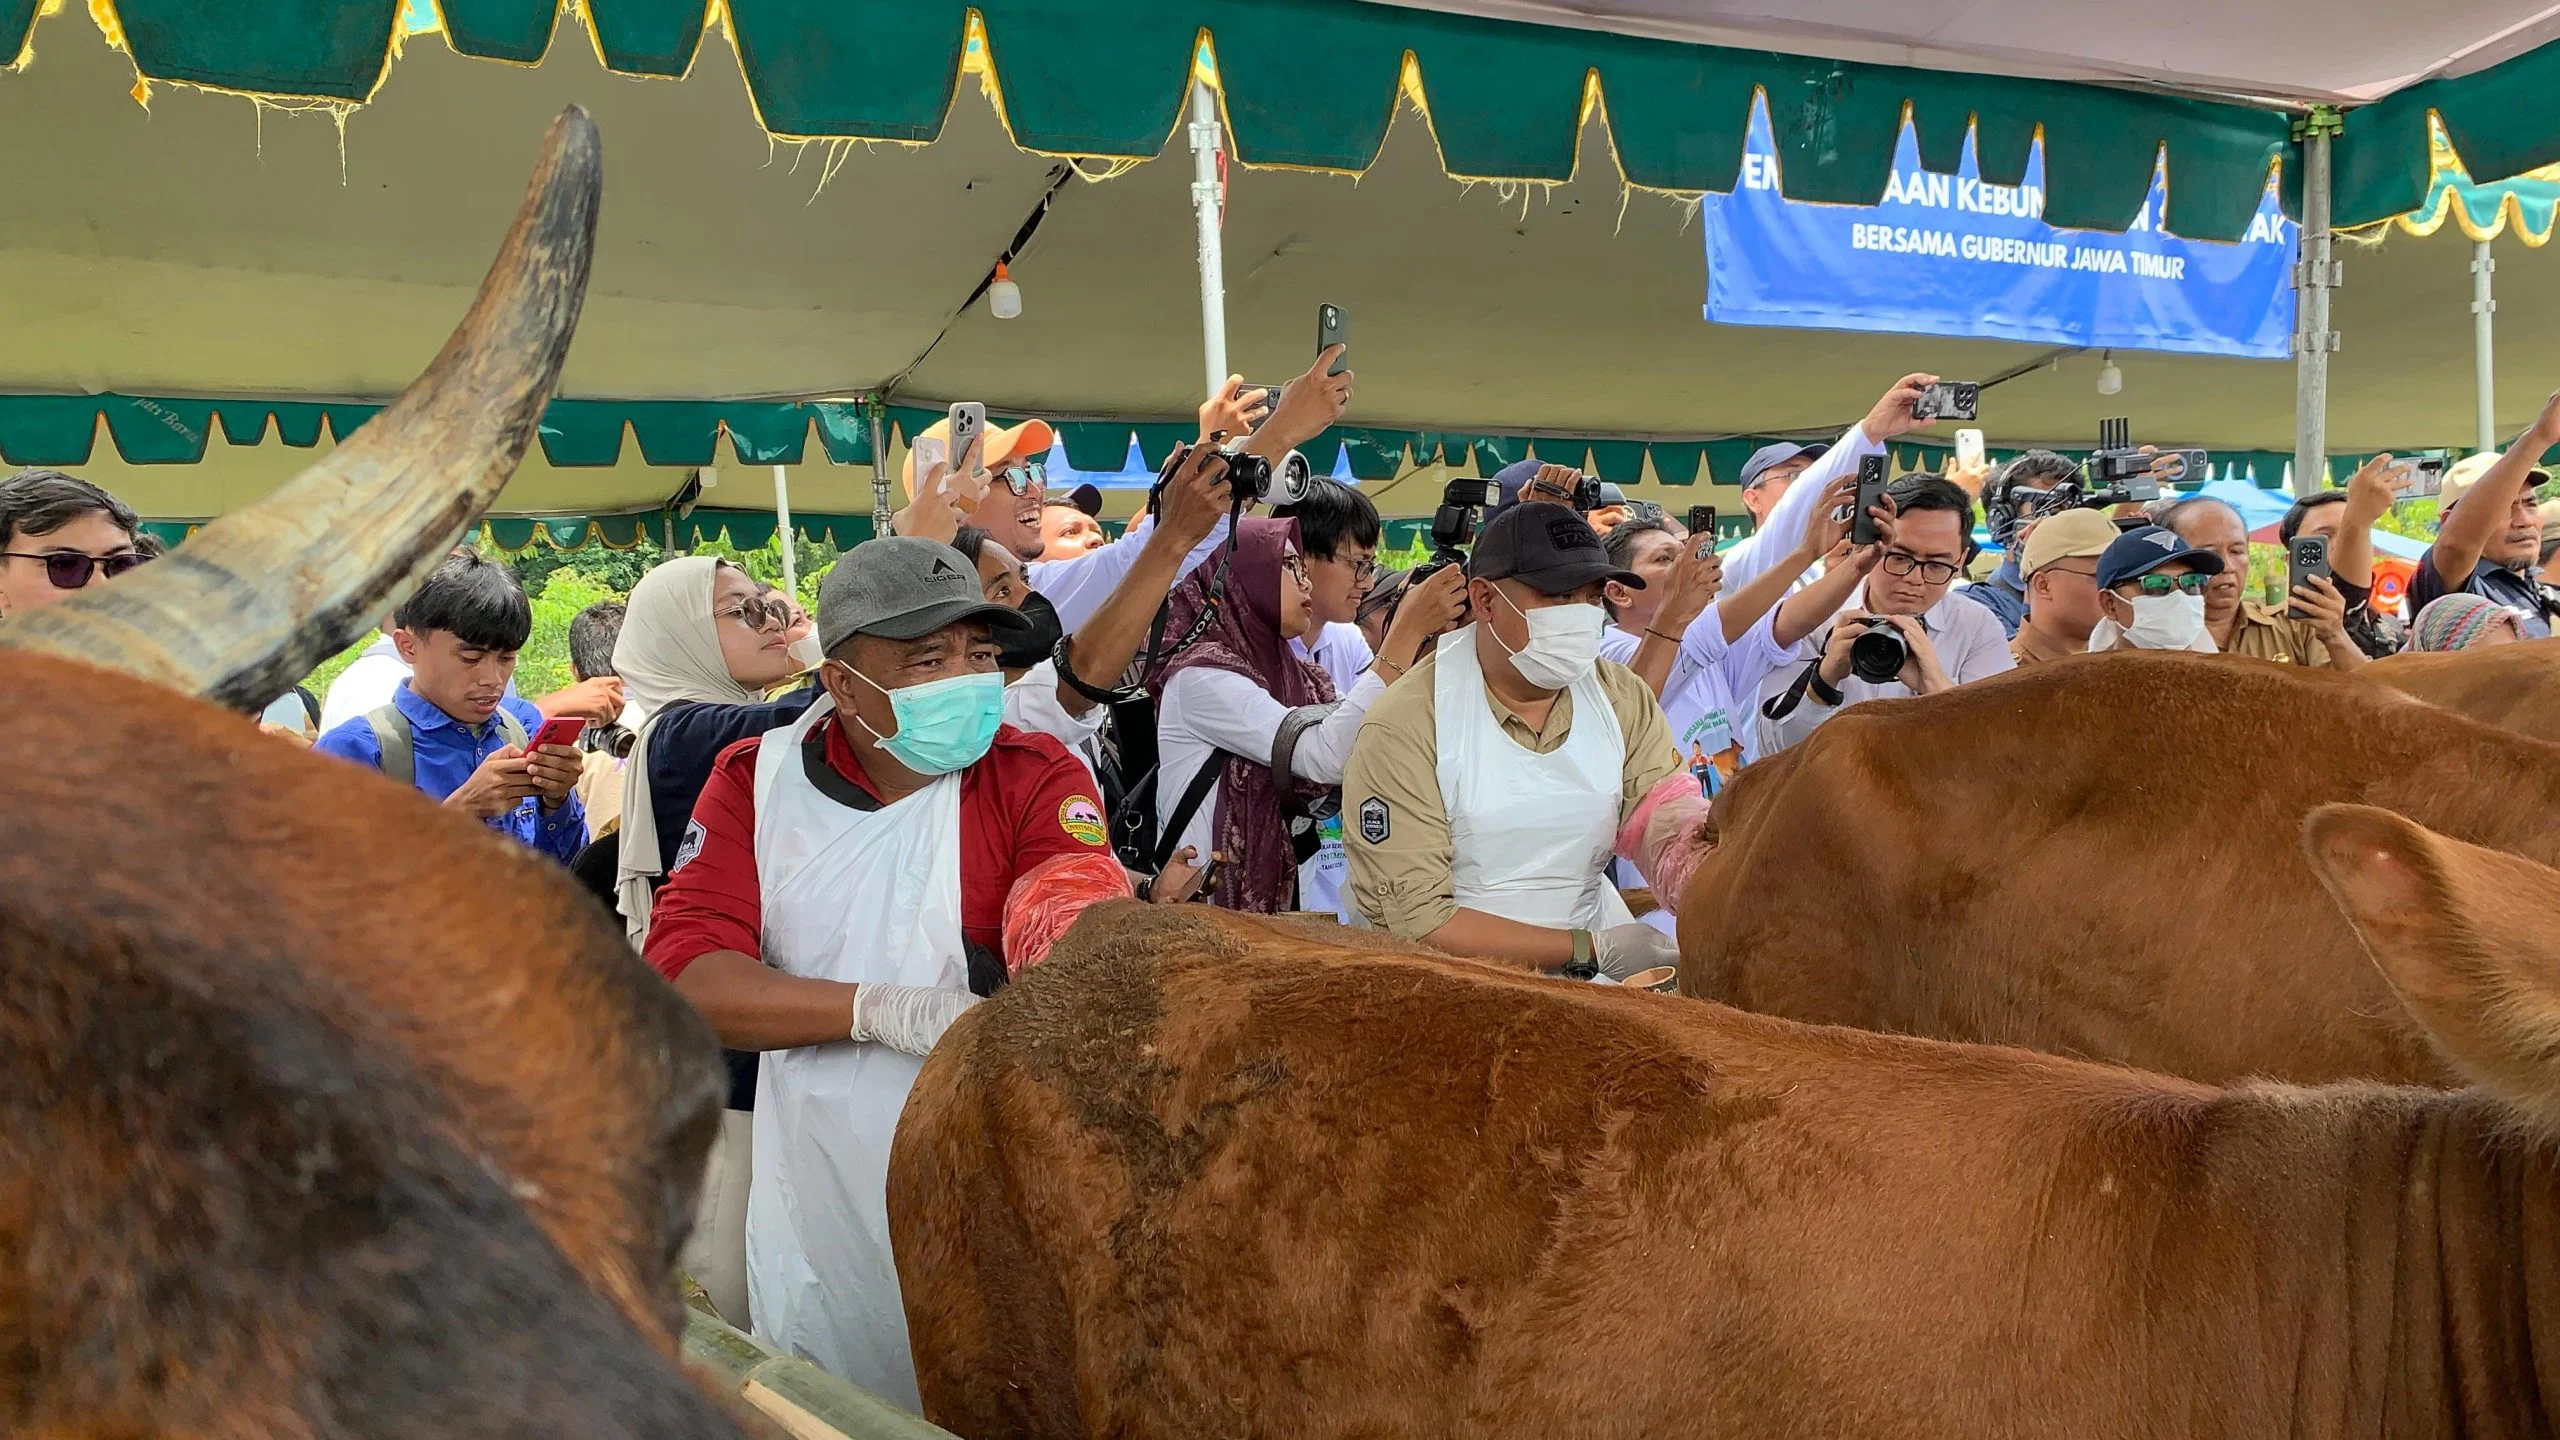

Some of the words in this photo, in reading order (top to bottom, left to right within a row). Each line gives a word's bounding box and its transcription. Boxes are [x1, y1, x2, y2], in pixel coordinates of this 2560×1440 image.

[1852, 222, 1958, 258] BERSAMA
[1961, 234, 2068, 269] GUBERNUR
[2070, 246, 2128, 274] JAWA
[2130, 250, 2185, 280] TIMUR
[924, 574, 966, 582] EIGER
[1177, 608, 1213, 652] SONY
